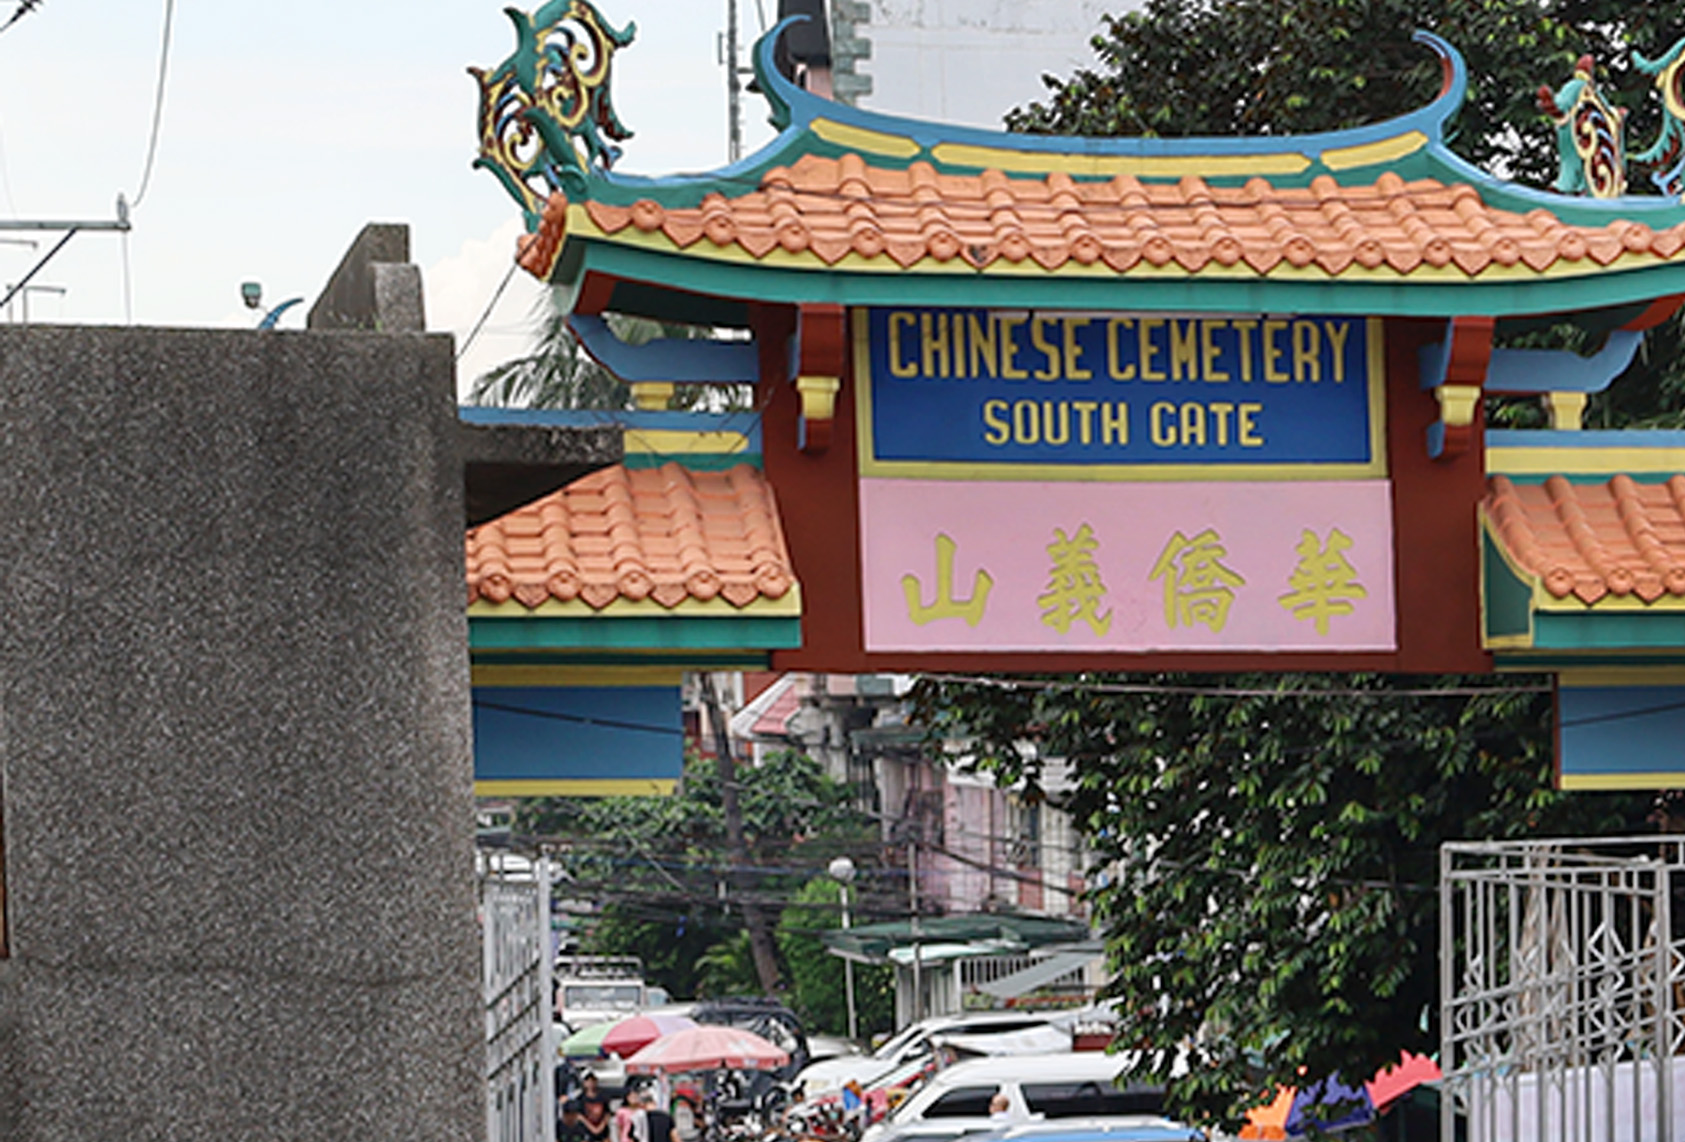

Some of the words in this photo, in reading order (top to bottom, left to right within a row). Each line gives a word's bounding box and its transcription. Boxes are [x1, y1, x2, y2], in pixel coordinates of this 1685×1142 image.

[888, 311, 1093, 381] CHINESE
[1106, 317, 1350, 383] CEMETERY
[984, 400, 1129, 446] SOUTH
[1150, 402, 1264, 447] GATE
